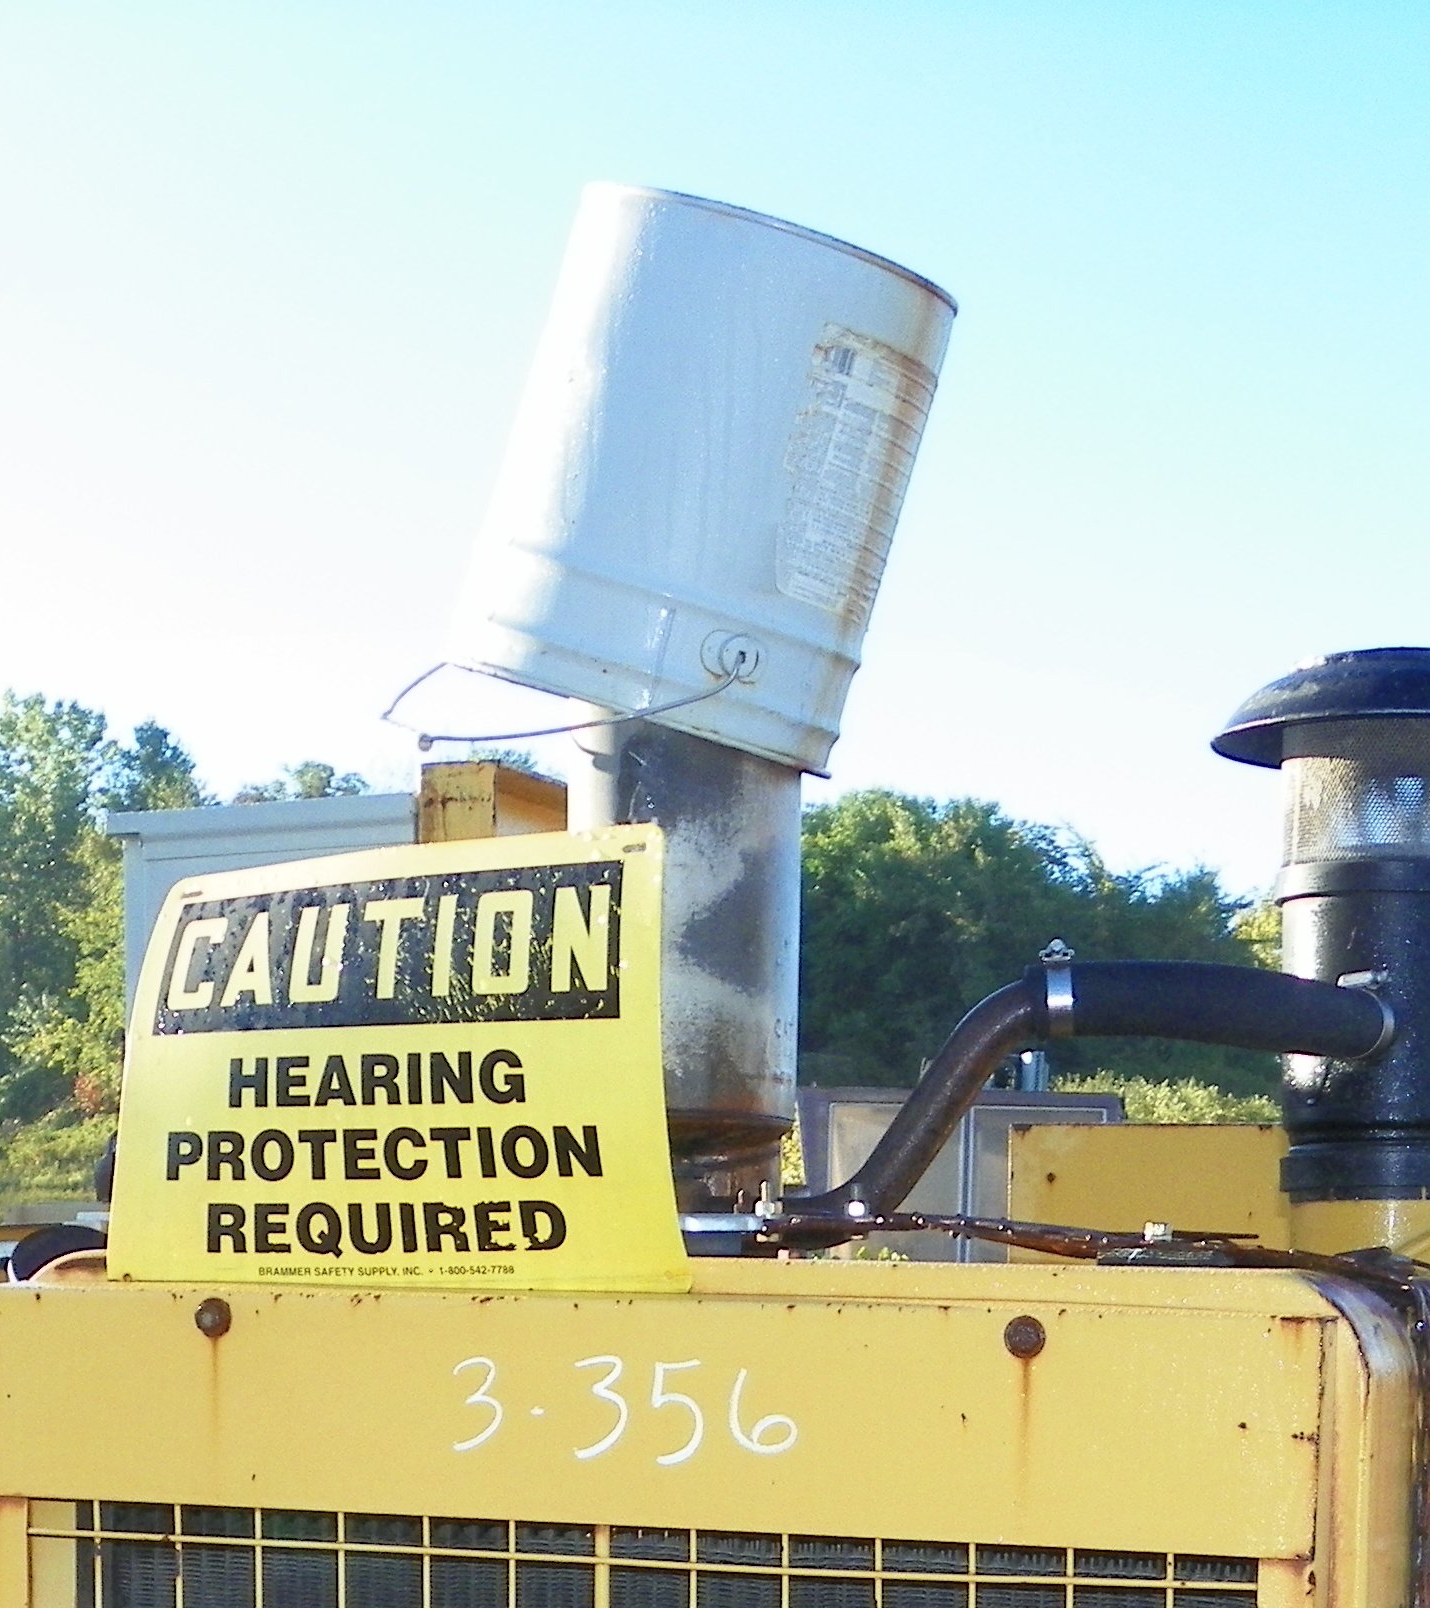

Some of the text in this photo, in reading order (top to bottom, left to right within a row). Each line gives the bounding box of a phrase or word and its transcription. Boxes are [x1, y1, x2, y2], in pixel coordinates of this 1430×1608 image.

[166, 884, 612, 1011] CAUTION
[227, 1048, 527, 1109] HEARING
[165, 1124, 604, 1182] PROTECTION
[205, 1199, 568, 1259] REQUIRED
[258, 1266, 312, 1277] BRAMMER
[314, 1266, 355, 1277] SAFETY
[402, 1265, 424, 1276] INC.
